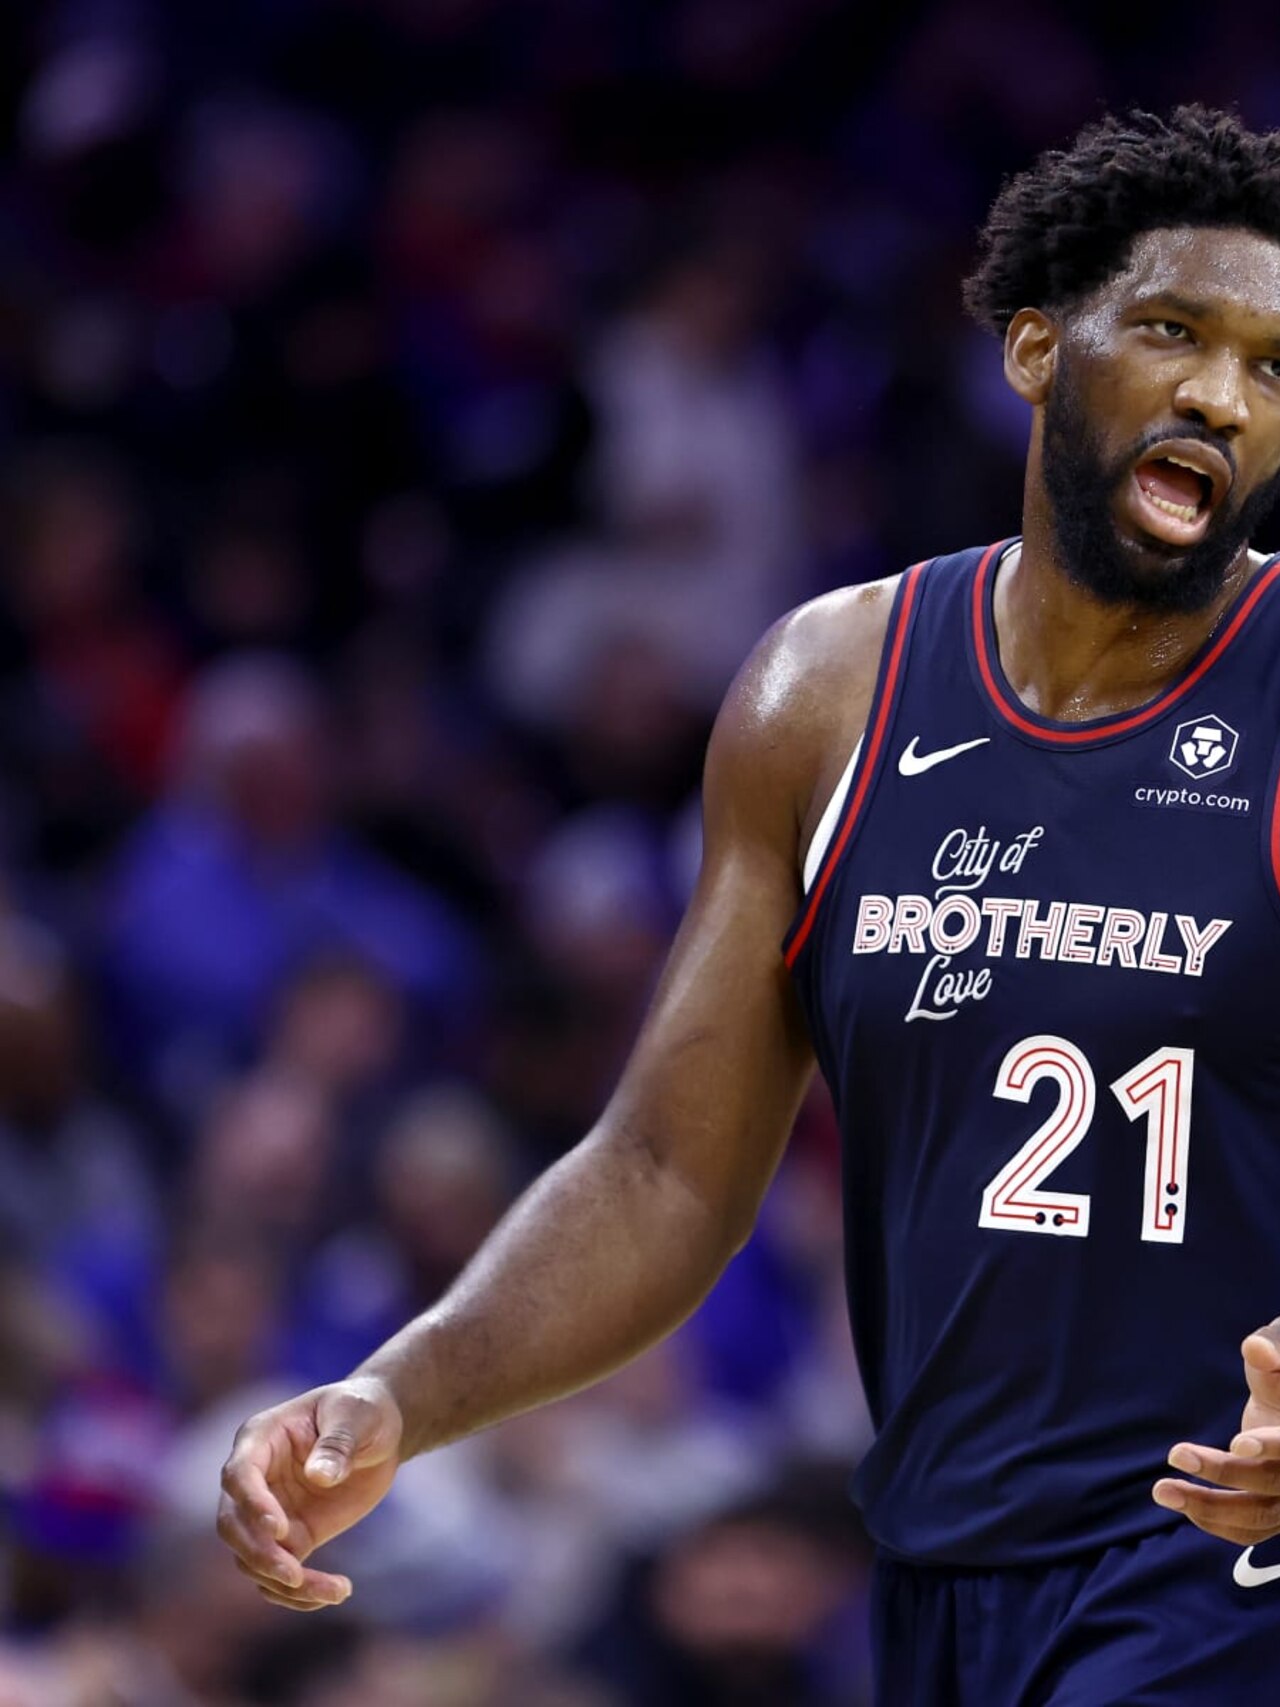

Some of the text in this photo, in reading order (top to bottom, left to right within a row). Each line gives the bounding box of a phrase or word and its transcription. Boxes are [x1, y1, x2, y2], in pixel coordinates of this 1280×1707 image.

[1135, 788, 1250, 811] crypto.com
[932, 826, 1044, 900] City of
[852, 894, 1233, 976] BROTHERLY
[905, 954, 992, 1023] Love
[978, 1035, 1194, 1243] 21
